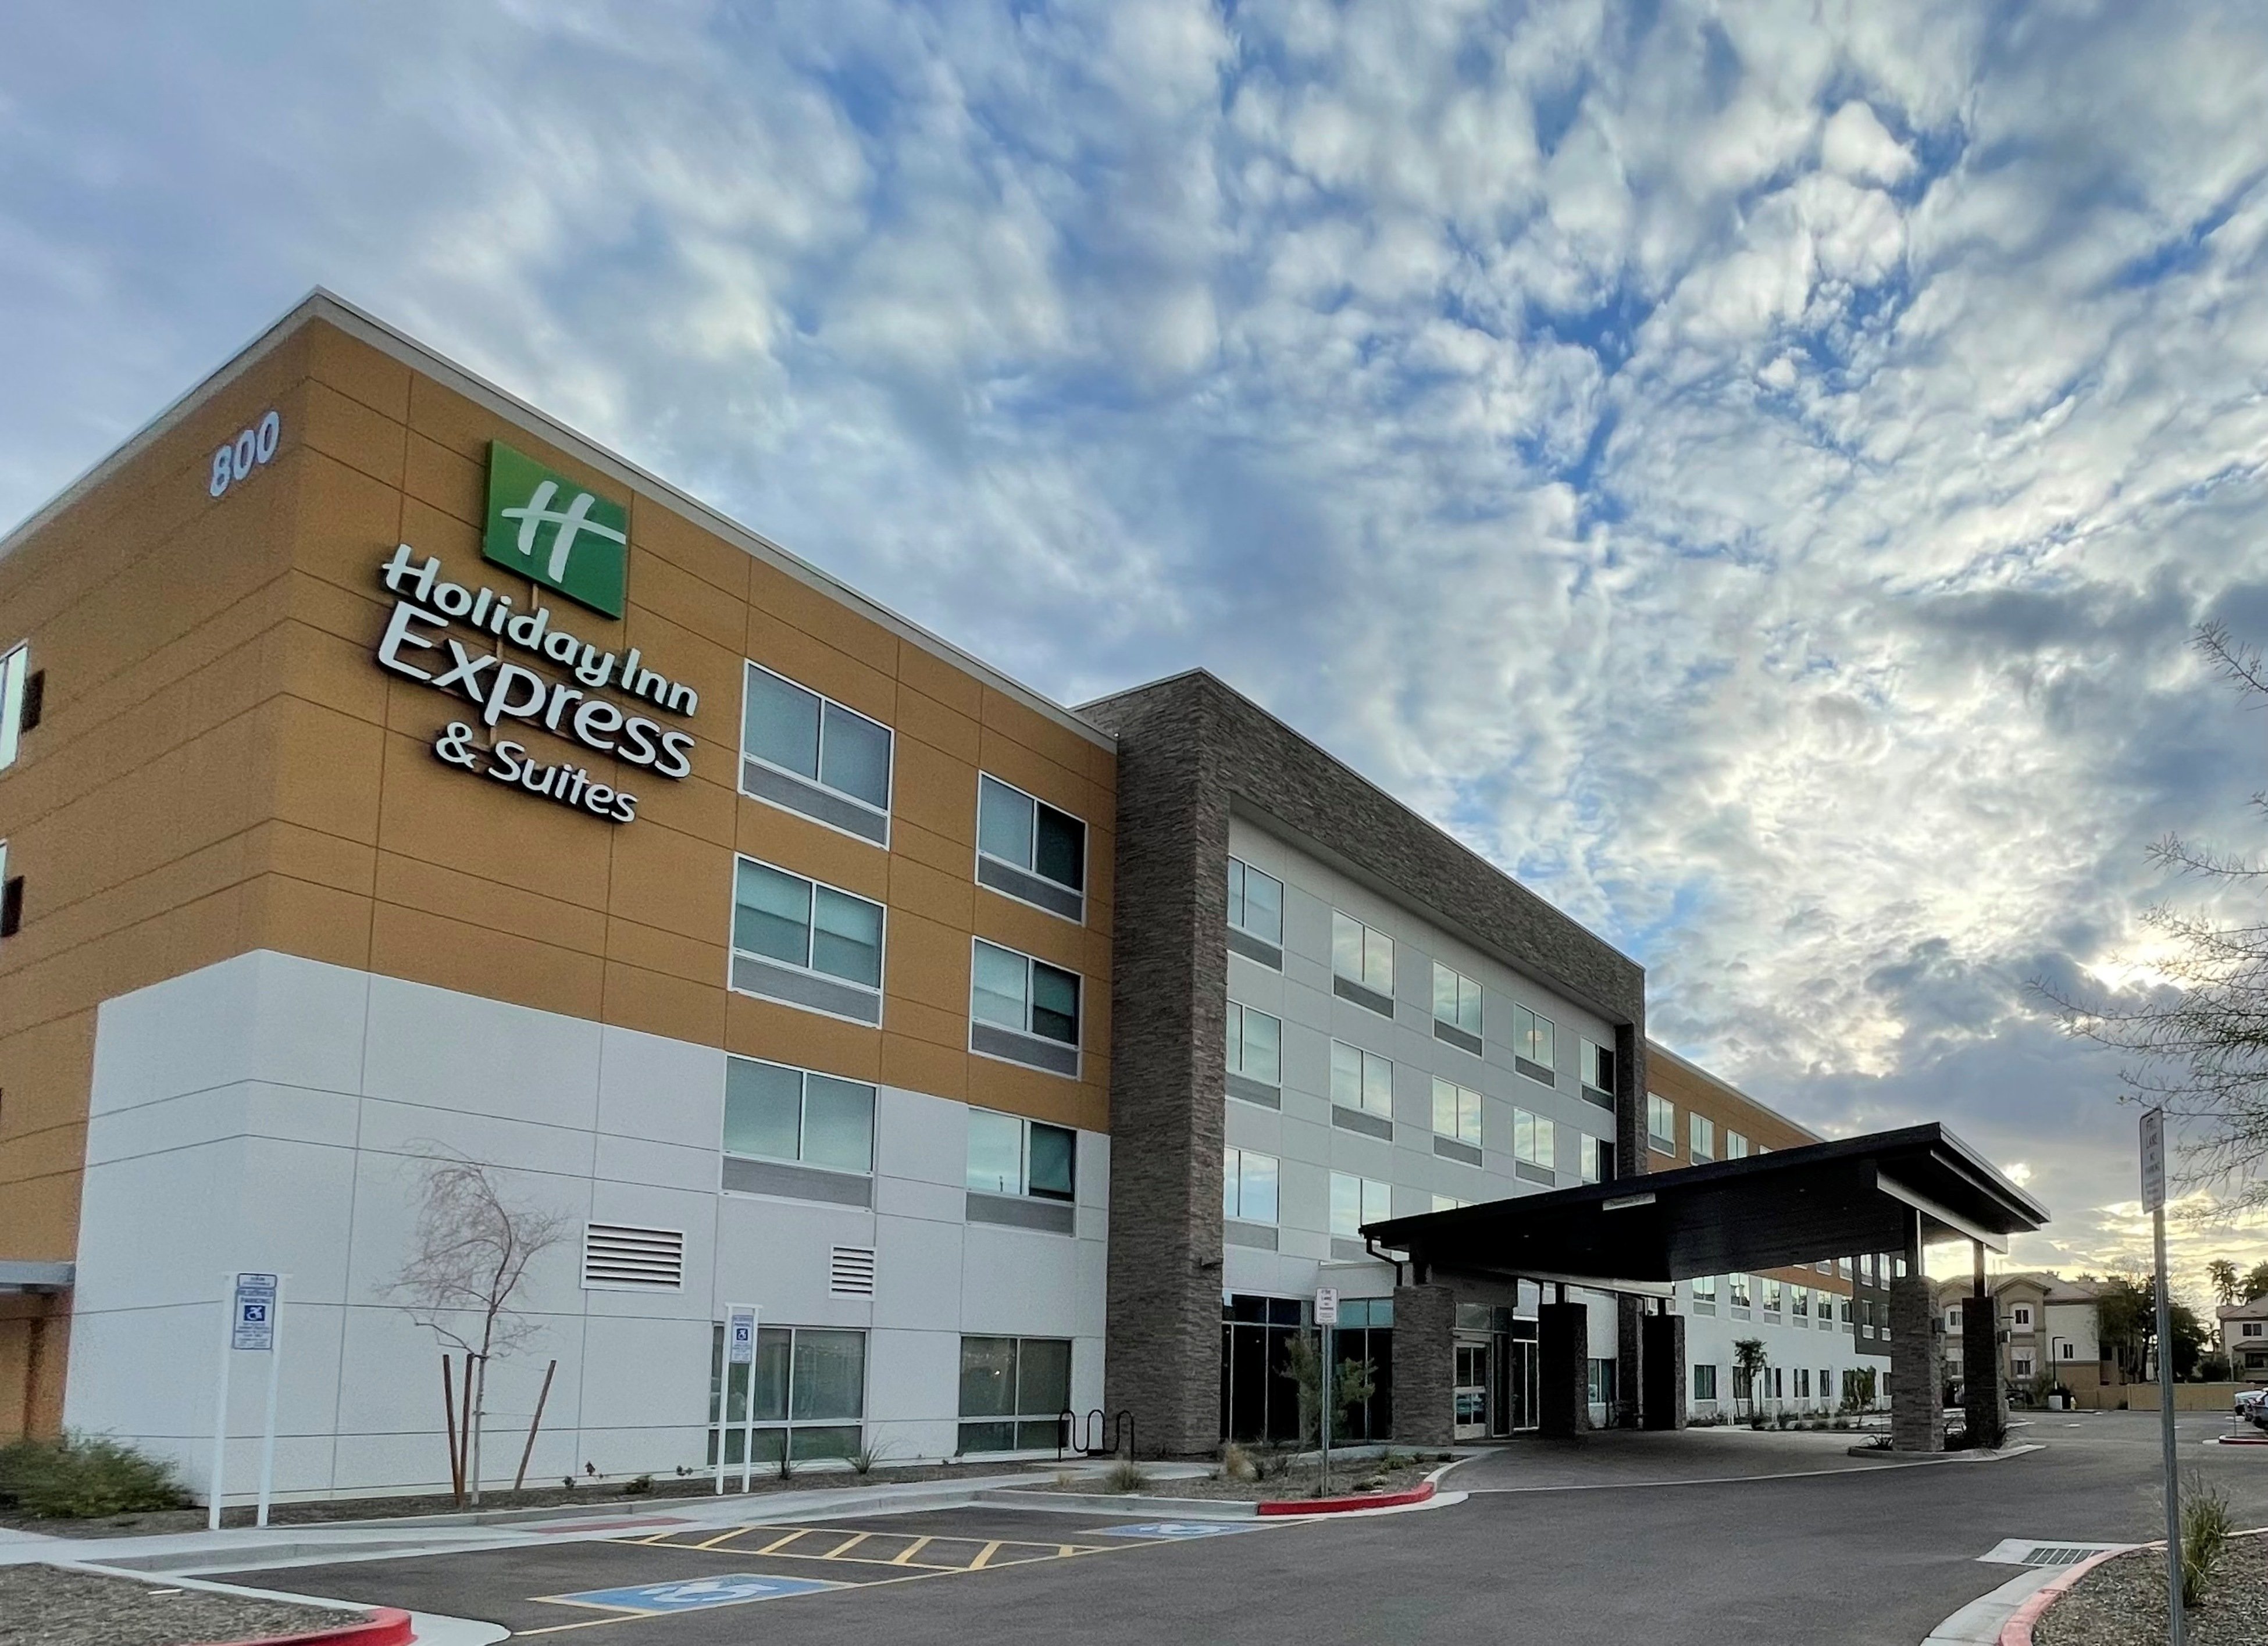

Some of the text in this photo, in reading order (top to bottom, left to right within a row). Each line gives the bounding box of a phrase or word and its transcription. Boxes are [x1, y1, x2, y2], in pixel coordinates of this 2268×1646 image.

[209, 410, 280, 497] 800
[378, 601, 696, 779] Express
[381, 544, 698, 717] Holiday Inn
[436, 722, 640, 823] & Suites
